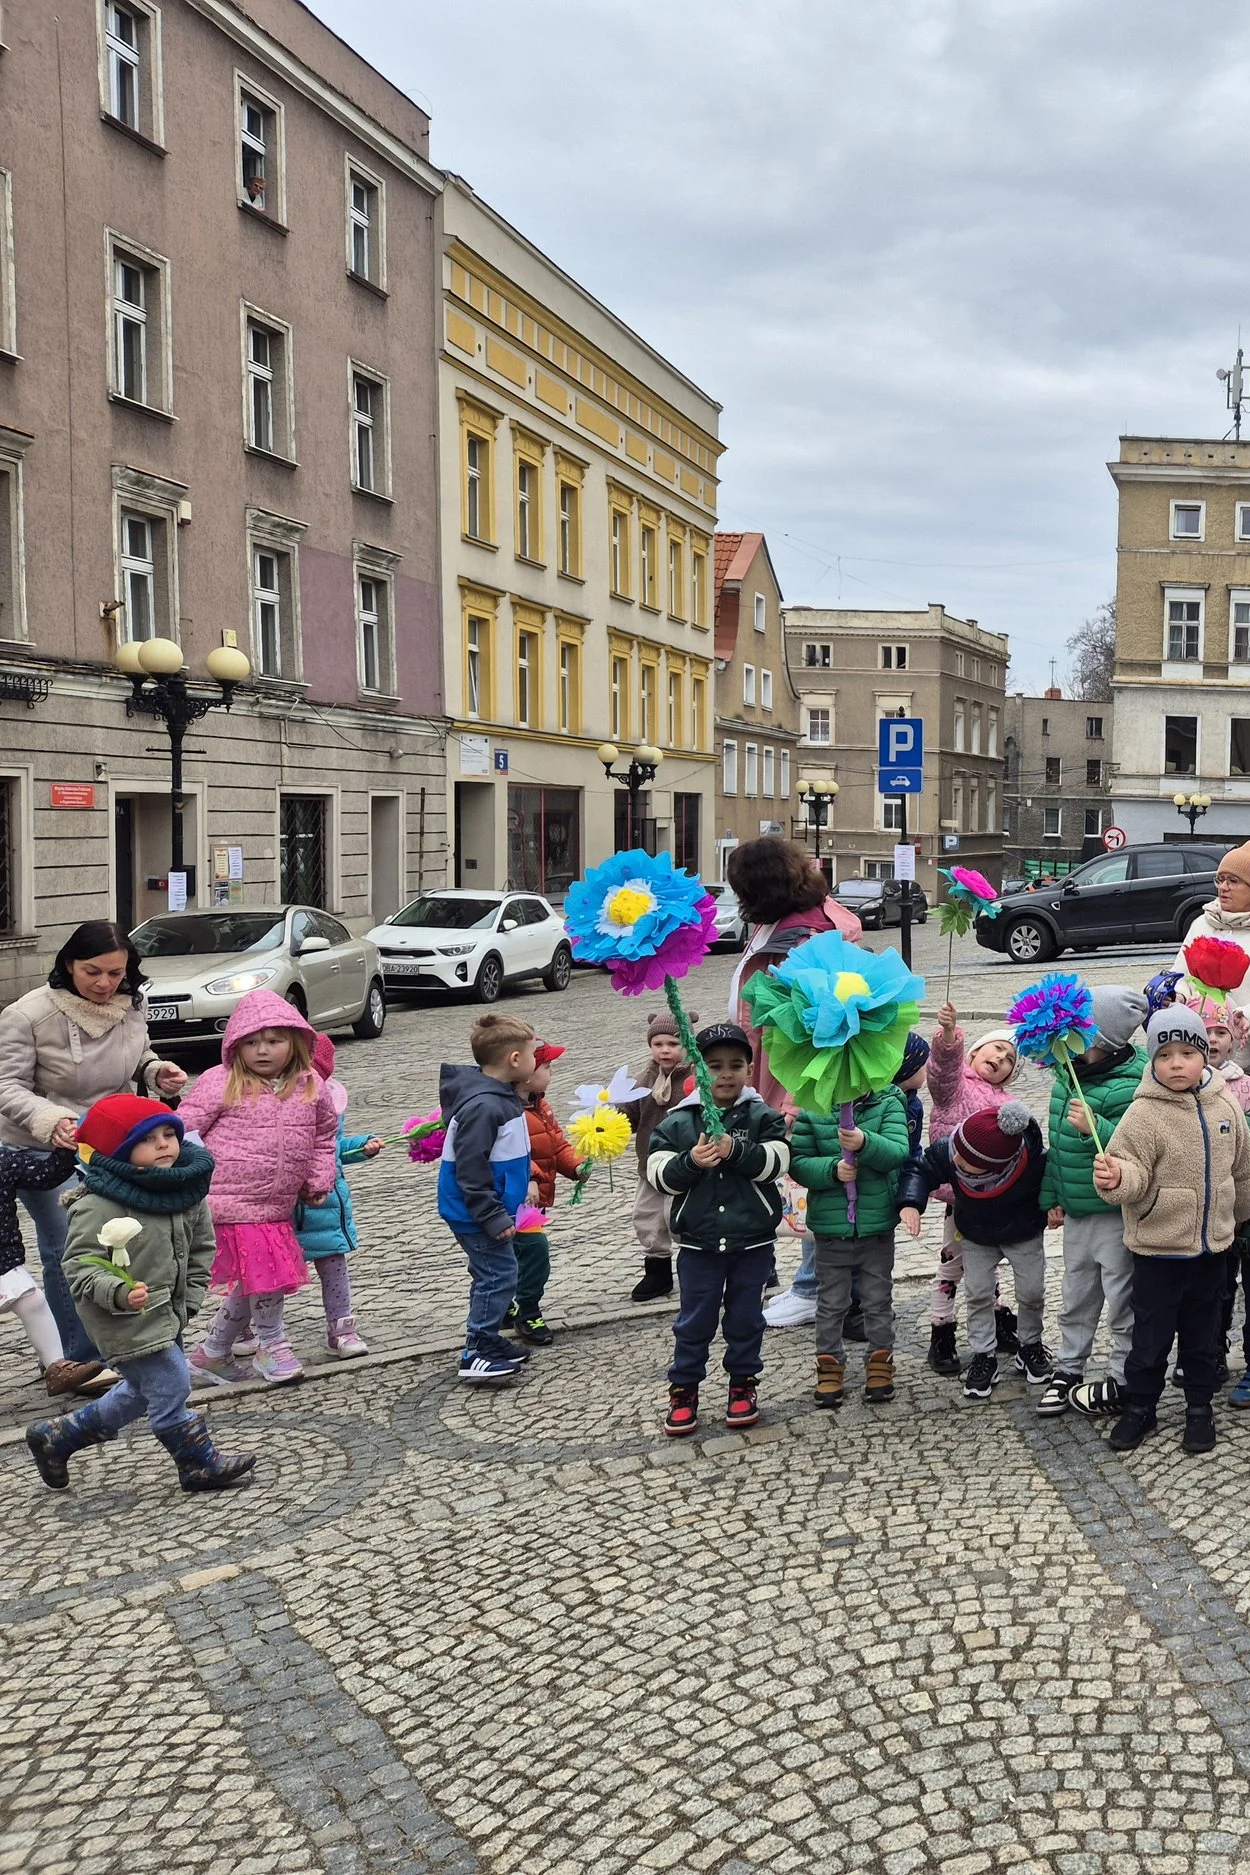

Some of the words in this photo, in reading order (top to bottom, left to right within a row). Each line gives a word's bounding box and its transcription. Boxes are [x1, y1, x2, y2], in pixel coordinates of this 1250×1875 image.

[889, 724, 914, 762] P
[499, 754, 504, 769] 5
[945, 835, 958, 849] P
